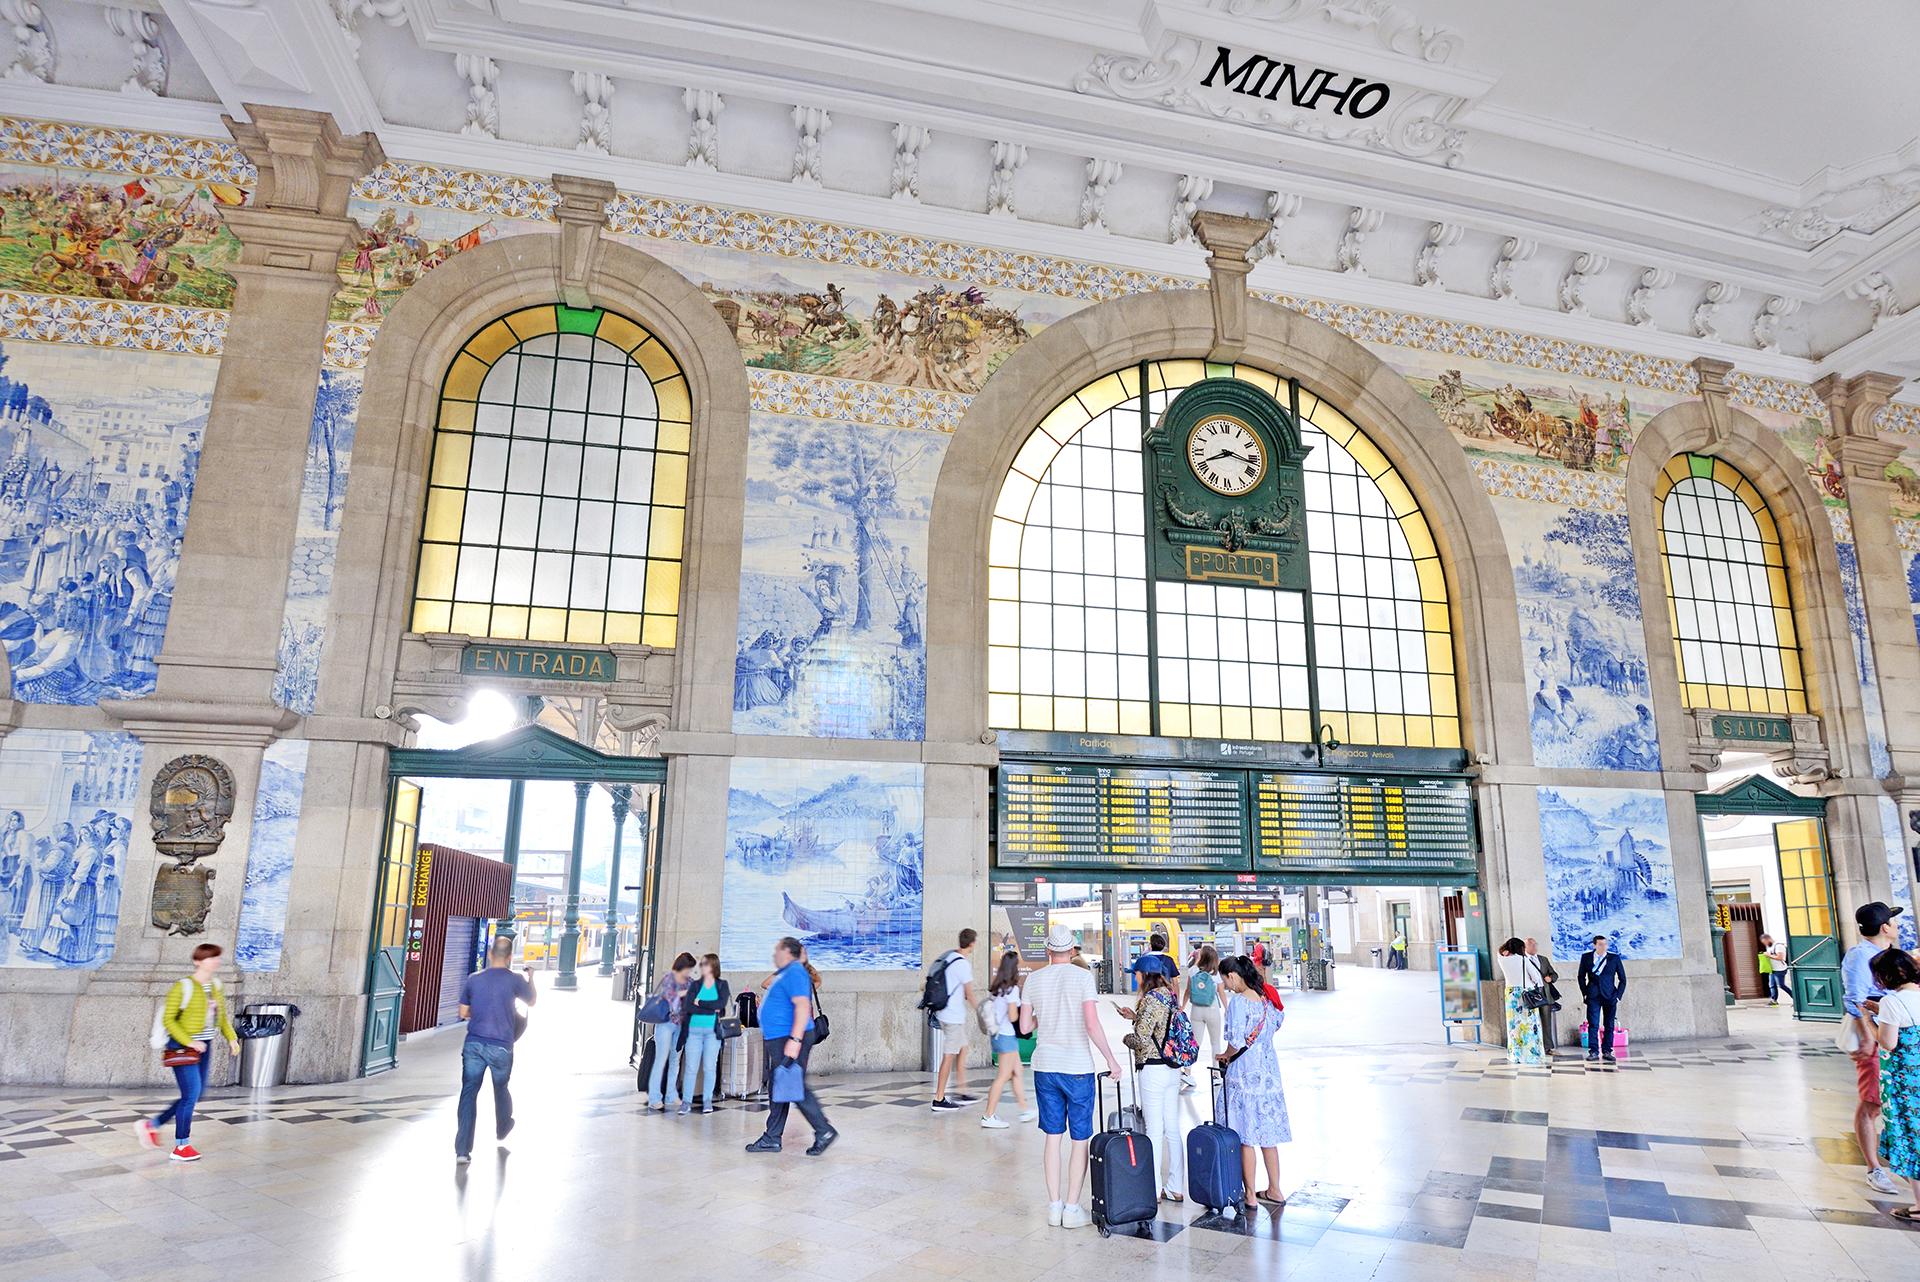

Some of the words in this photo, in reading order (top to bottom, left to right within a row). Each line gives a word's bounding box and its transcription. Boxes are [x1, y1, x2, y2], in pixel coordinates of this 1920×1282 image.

[1200, 46, 1391, 119] MINHO
[1201, 553, 1263, 575] PORTO
[475, 649, 602, 676] ENTRADA
[1722, 720, 1781, 737] SAIDA
[416, 849, 432, 906] EXCHANGE
[1033, 925, 1045, 934] 2€
[1721, 904, 1732, 931] BOLOS
